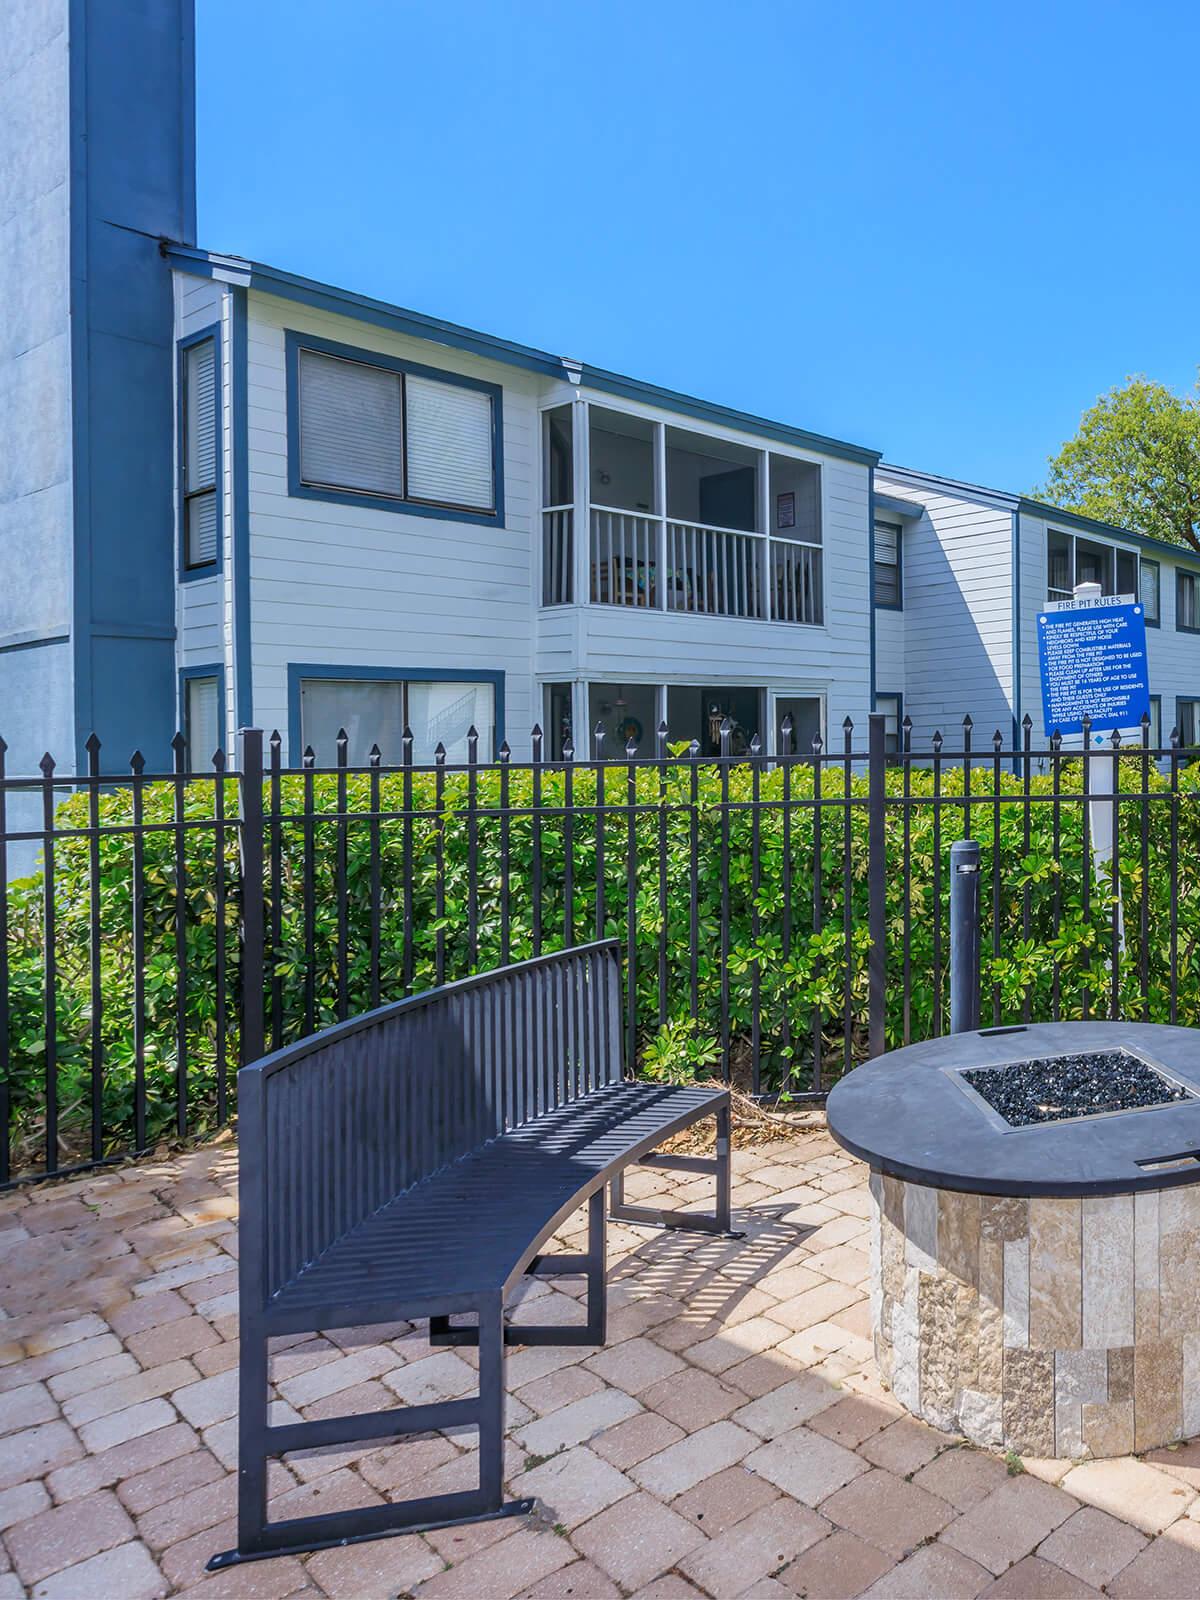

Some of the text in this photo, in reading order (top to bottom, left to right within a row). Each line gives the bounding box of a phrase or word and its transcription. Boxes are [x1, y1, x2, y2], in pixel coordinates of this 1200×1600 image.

[1058, 597, 1121, 610] FIRE PIT RULES
